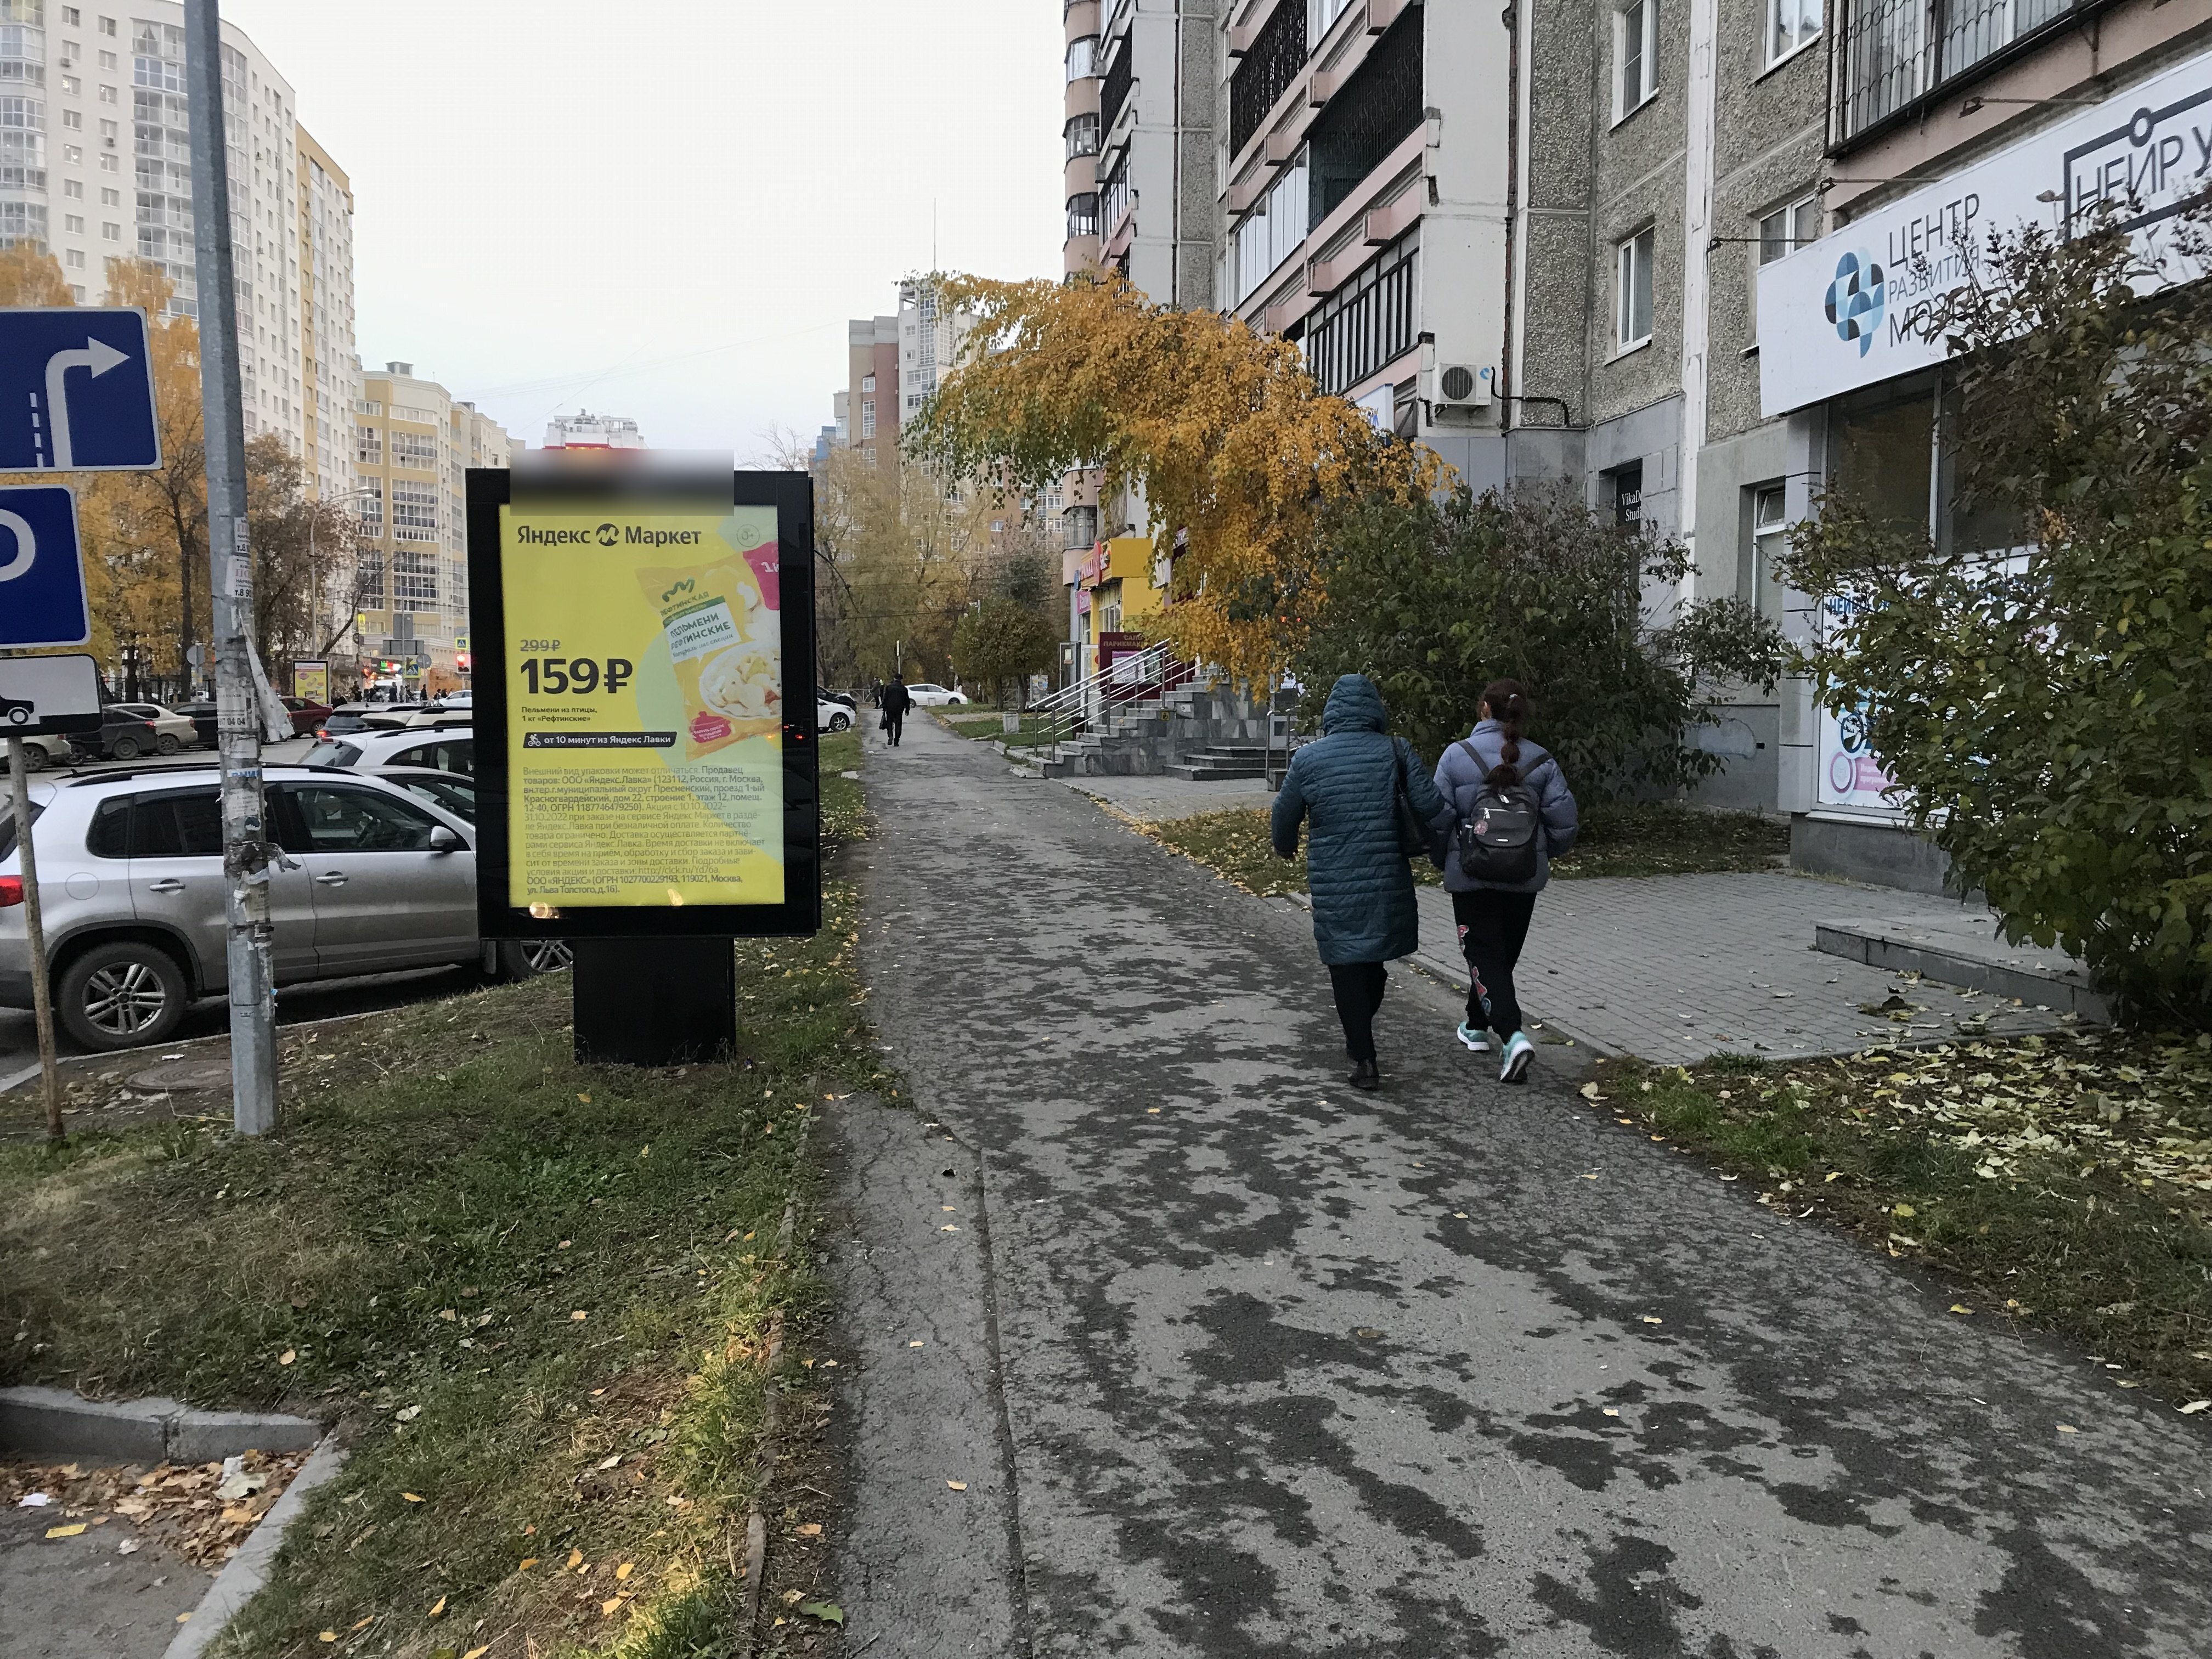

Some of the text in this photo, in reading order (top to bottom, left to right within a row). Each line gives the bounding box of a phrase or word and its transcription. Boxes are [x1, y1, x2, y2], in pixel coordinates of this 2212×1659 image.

[1889, 194, 1979, 270] ЦЕНТР
[1889, 245, 1979, 303] РАЗВИТИЯ
[518, 526, 702, 547] Яндекс Маркет
[660, 591, 709, 616] РЕФТИНСКАЯ
[670, 612, 719, 637] ПЕЛЬМЕНИ
[671, 622, 731, 650] РЕФТИНСКИЕ
[710, 634, 733, 645] специи
[521, 658, 633, 694] 159₽
[610, 736, 641, 744] Яндекс
[523, 766, 561, 775] Внешний
[702, 765, 743, 775] Продавец
[562, 775, 583, 783] ООО
[584, 775, 652, 784] «Яндекс.Лавка»
[654, 775, 688, 784] (123112,
[690, 774, 721, 783] Россия,
[729, 774, 763, 783] Москва,
[654, 783, 712, 793] Пресненский,
[745, 783, 765, 791] 1-ый
[632, 793, 644, 802] 22,
[687, 793, 694, 802] 1,
[718, 792, 729, 802] 12,
[524, 803, 549, 812] 12-40,
[550, 803, 574, 811] ОГРН
[646, 802, 672, 811] Акция
[524, 812, 567, 820] 31.10.2022
[663, 811, 692, 820] Яндекс
[695, 811, 725, 820] Маркет
[537, 821, 593, 830] Яндекс.Лавка
[613, 820, 668, 828] безналичной
[703, 820, 751, 828] Количество
[610, 830, 648, 839] Доставка
[646, 838, 673, 848] Время
[532, 849, 551, 857] себя
[592, 848, 622, 857] приём,
[624, 848, 668, 857] обработку
[678, 848, 698, 857] сбор
[692, 856, 740, 866] Подробные
[527, 874, 742, 885] ООО «ЯНДЕКС» (ОГРН 1027700229193, 119021, Москва,
[539, 885, 558, 893] Льва
